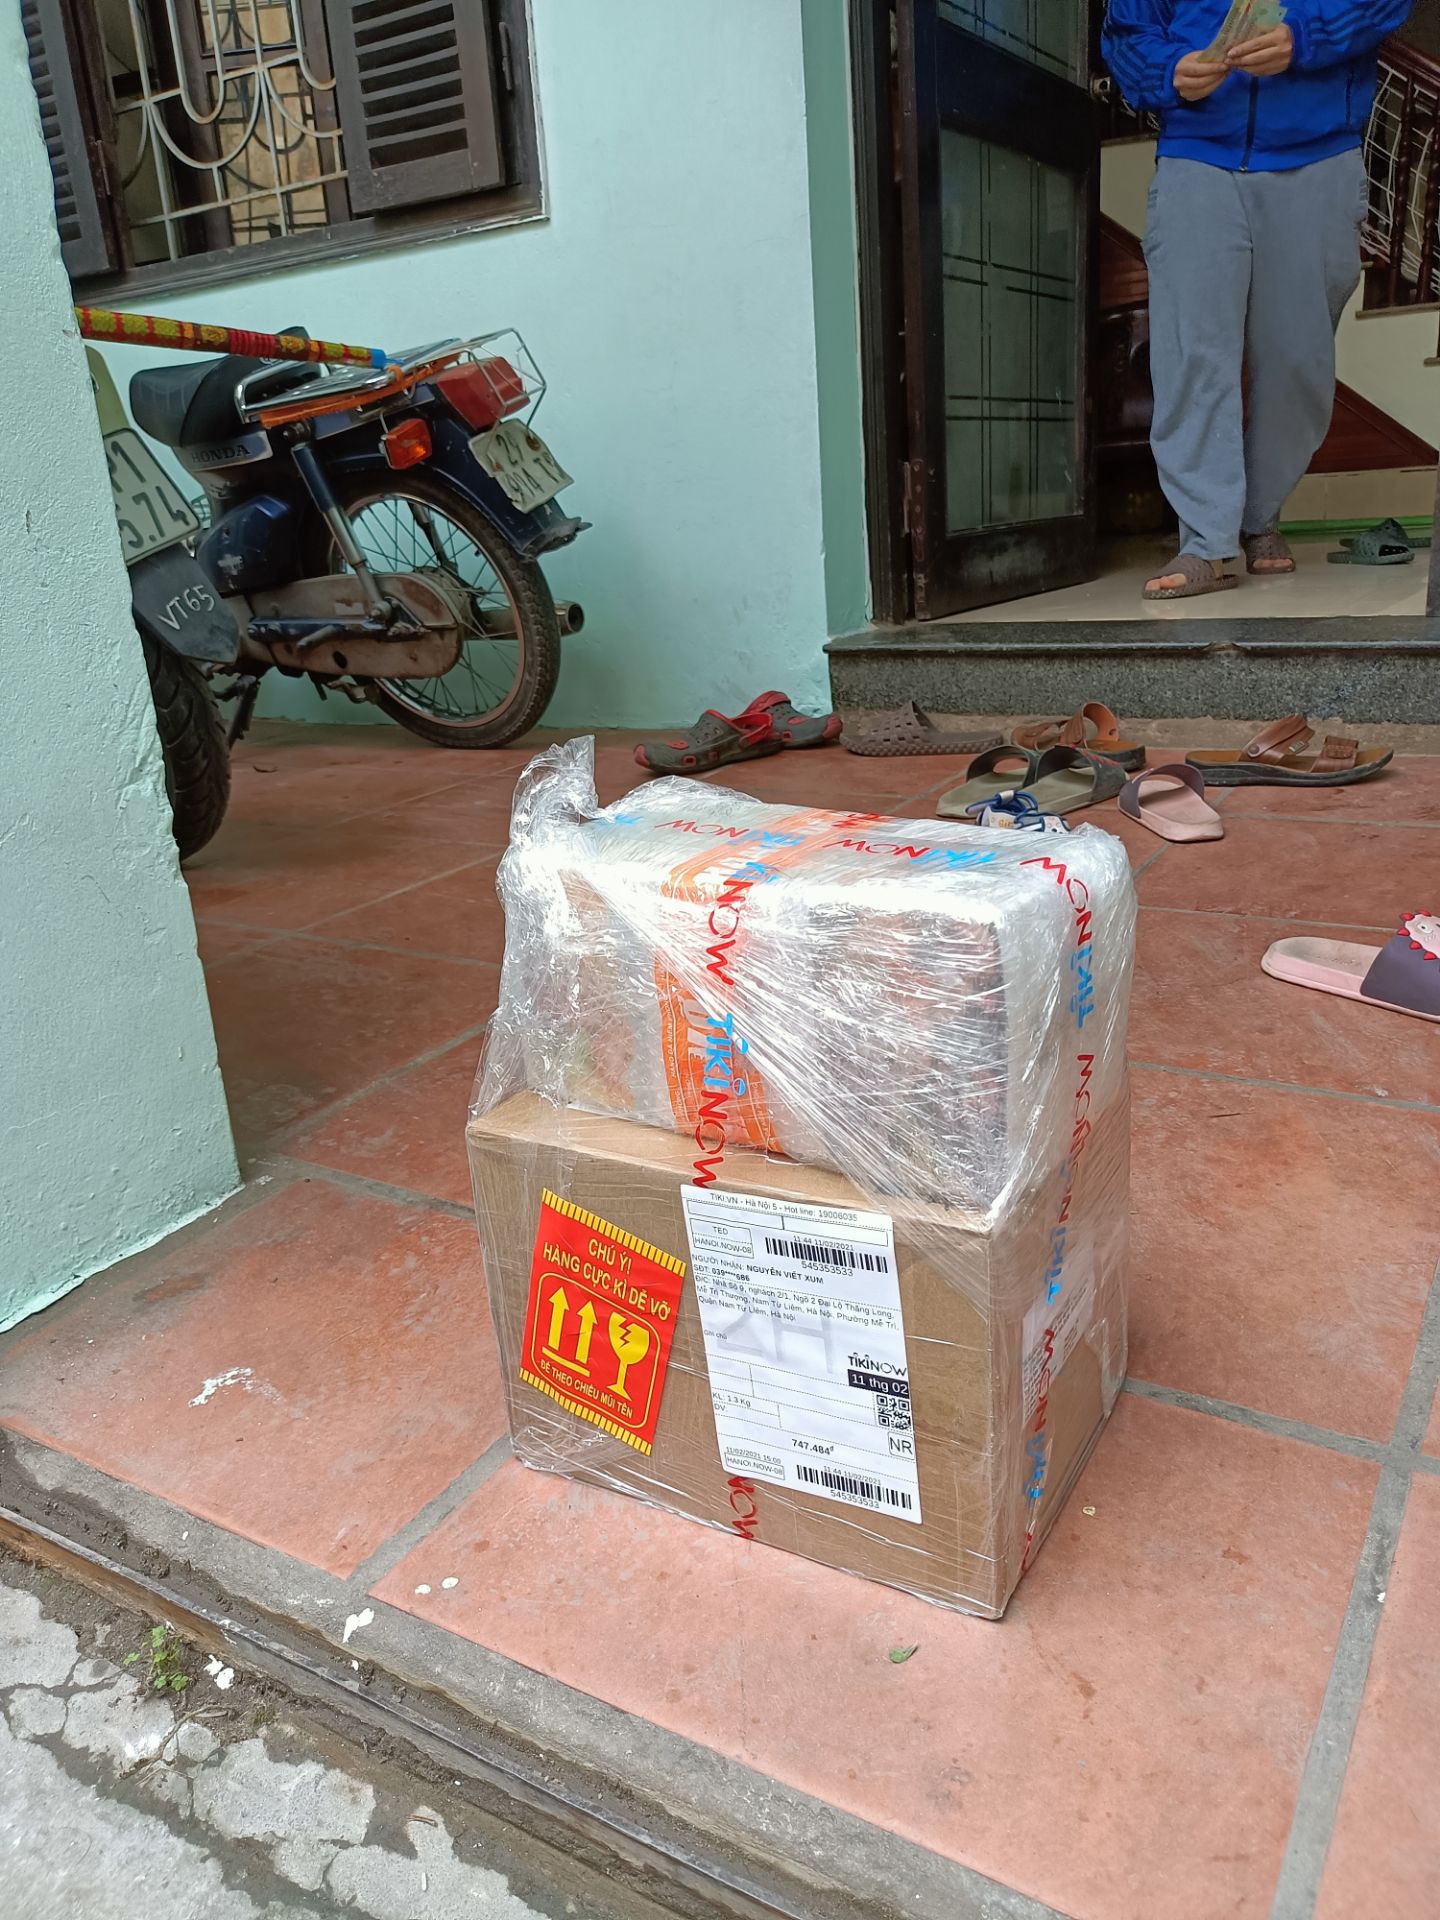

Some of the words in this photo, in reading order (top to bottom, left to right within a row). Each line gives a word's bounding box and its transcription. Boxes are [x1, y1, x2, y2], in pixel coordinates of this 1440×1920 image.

[191, 443, 252, 464] HONDA
[158, 584, 215, 631] VT65
[710, 1193, 738, 1204] TIKI.VN
[745, 1199, 756, 1207] Hà
[757, 1200, 771, 1210] Nội
[773, 1203, 778, 1211] 5
[784, 1205, 798, 1214] Hot
[818, 1209, 858, 1221] 19006035
[713, 1226, 728, 1235] TED
[815, 1239, 855, 1251] 11/02/2021
[588, 1238, 616, 1266] CHÚ
[619, 1251, 632, 1275] Ý!
[692, 1254, 719, 1265] NGƯỜI
[746, 1264, 782, 1277] NGUYỄN
[804, 1274, 824, 1284] XUM
[801, 1260, 853, 1276] 545353533
[543, 1241, 581, 1273] HÀNG
[583, 1262, 611, 1290] CỰC
[613, 1278, 627, 1300] KÌ
[628, 1287, 648, 1311] DỄ
[650, 1297, 671, 1321] VỠ
[712, 1278, 727, 1287] Nhà
[698, 1295, 717, 1305] Quận
[719, 1299, 735, 1309] Nam
[771, 1310, 781, 1319] Hà
[752, 1297, 769, 1306] Nam
[806, 1307, 818, 1315] Hà
[837, 1312, 869, 1326] Phường
[540, 1359, 551, 1374] ĐỂ
[551, 1366, 573, 1387] THEO
[574, 1379, 599, 1400] CHIỀU
[600, 1392, 616, 1409] MŨI
[616, 1401, 633, 1419] TÊN
[852, 1373, 866, 1386] 11
[869, 1377, 889, 1392] thg
[892, 1382, 909, 1395] 02
[889, 1437, 913, 1454] NR
[844, 1469, 881, 1486] 11/02/2021
[830, 1489, 880, 1509] 545353533
